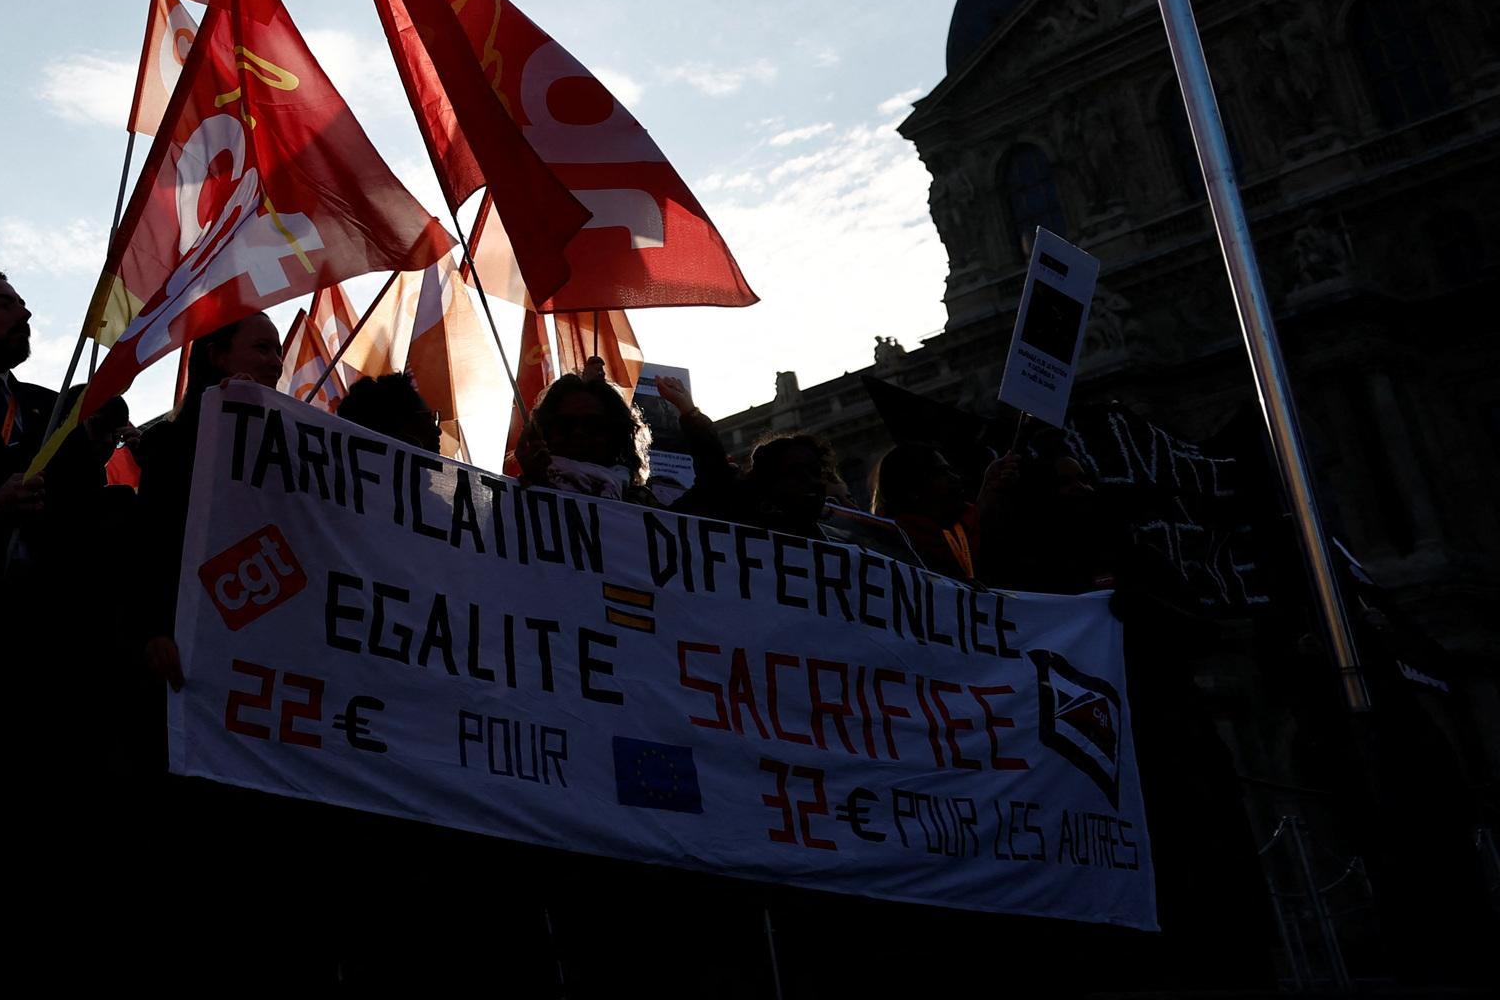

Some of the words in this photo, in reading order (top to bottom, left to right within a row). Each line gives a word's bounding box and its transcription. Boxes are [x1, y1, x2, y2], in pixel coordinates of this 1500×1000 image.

[212, 400, 603, 573] TARIFICATION
[214, 535, 295, 611] cgt
[325, 570, 624, 706] EGALITE
[677, 640, 1030, 770] SACRIFIEE
[458, 709, 568, 788] POUR
[891, 788, 979, 858] POUR
[994, 799, 1046, 861] LES
[1058, 808, 1140, 870] AUTRES
